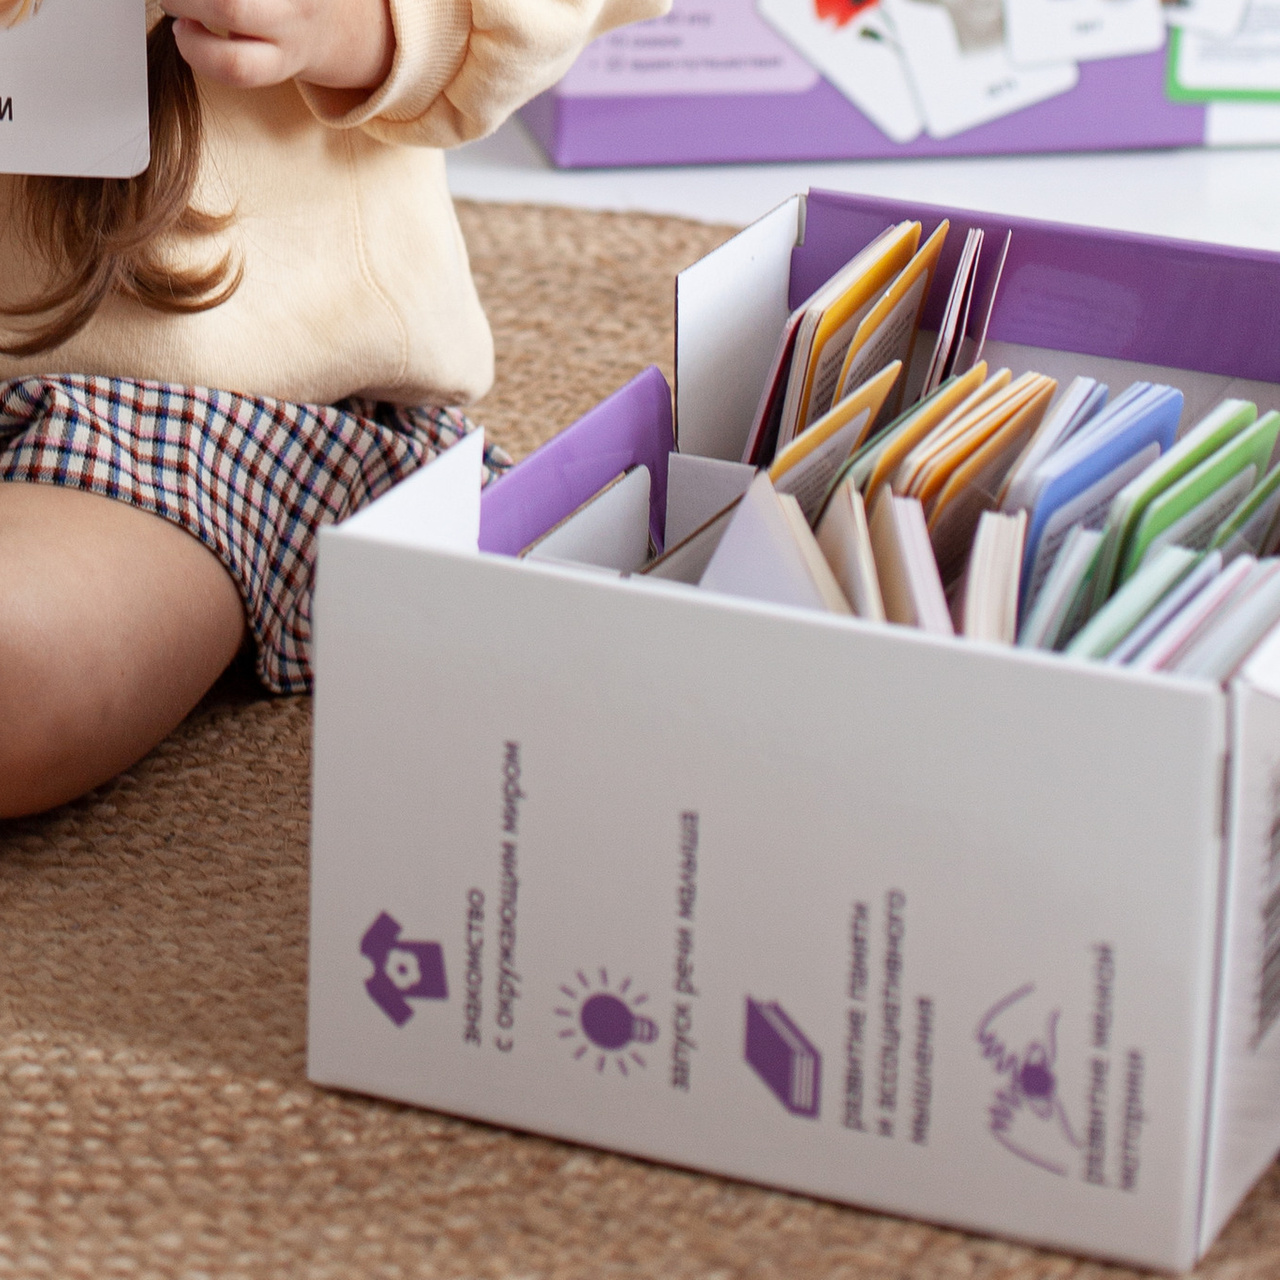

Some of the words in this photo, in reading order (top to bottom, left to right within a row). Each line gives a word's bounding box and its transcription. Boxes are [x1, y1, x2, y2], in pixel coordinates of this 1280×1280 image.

[503, 741, 526, 833] миром
[679, 810, 700, 920] малыша
[466, 887, 485, 1047] знакомство
[498, 842, 521, 1029] окружающим
[675, 926, 699, 996] речи
[850, 901, 870, 1002] памяти
[496, 1037, 513, 1053] с
[671, 1002, 699, 1091] запуск
[878, 888, 907, 1113] ассоциативного
[842, 1008, 868, 1134] развитие
